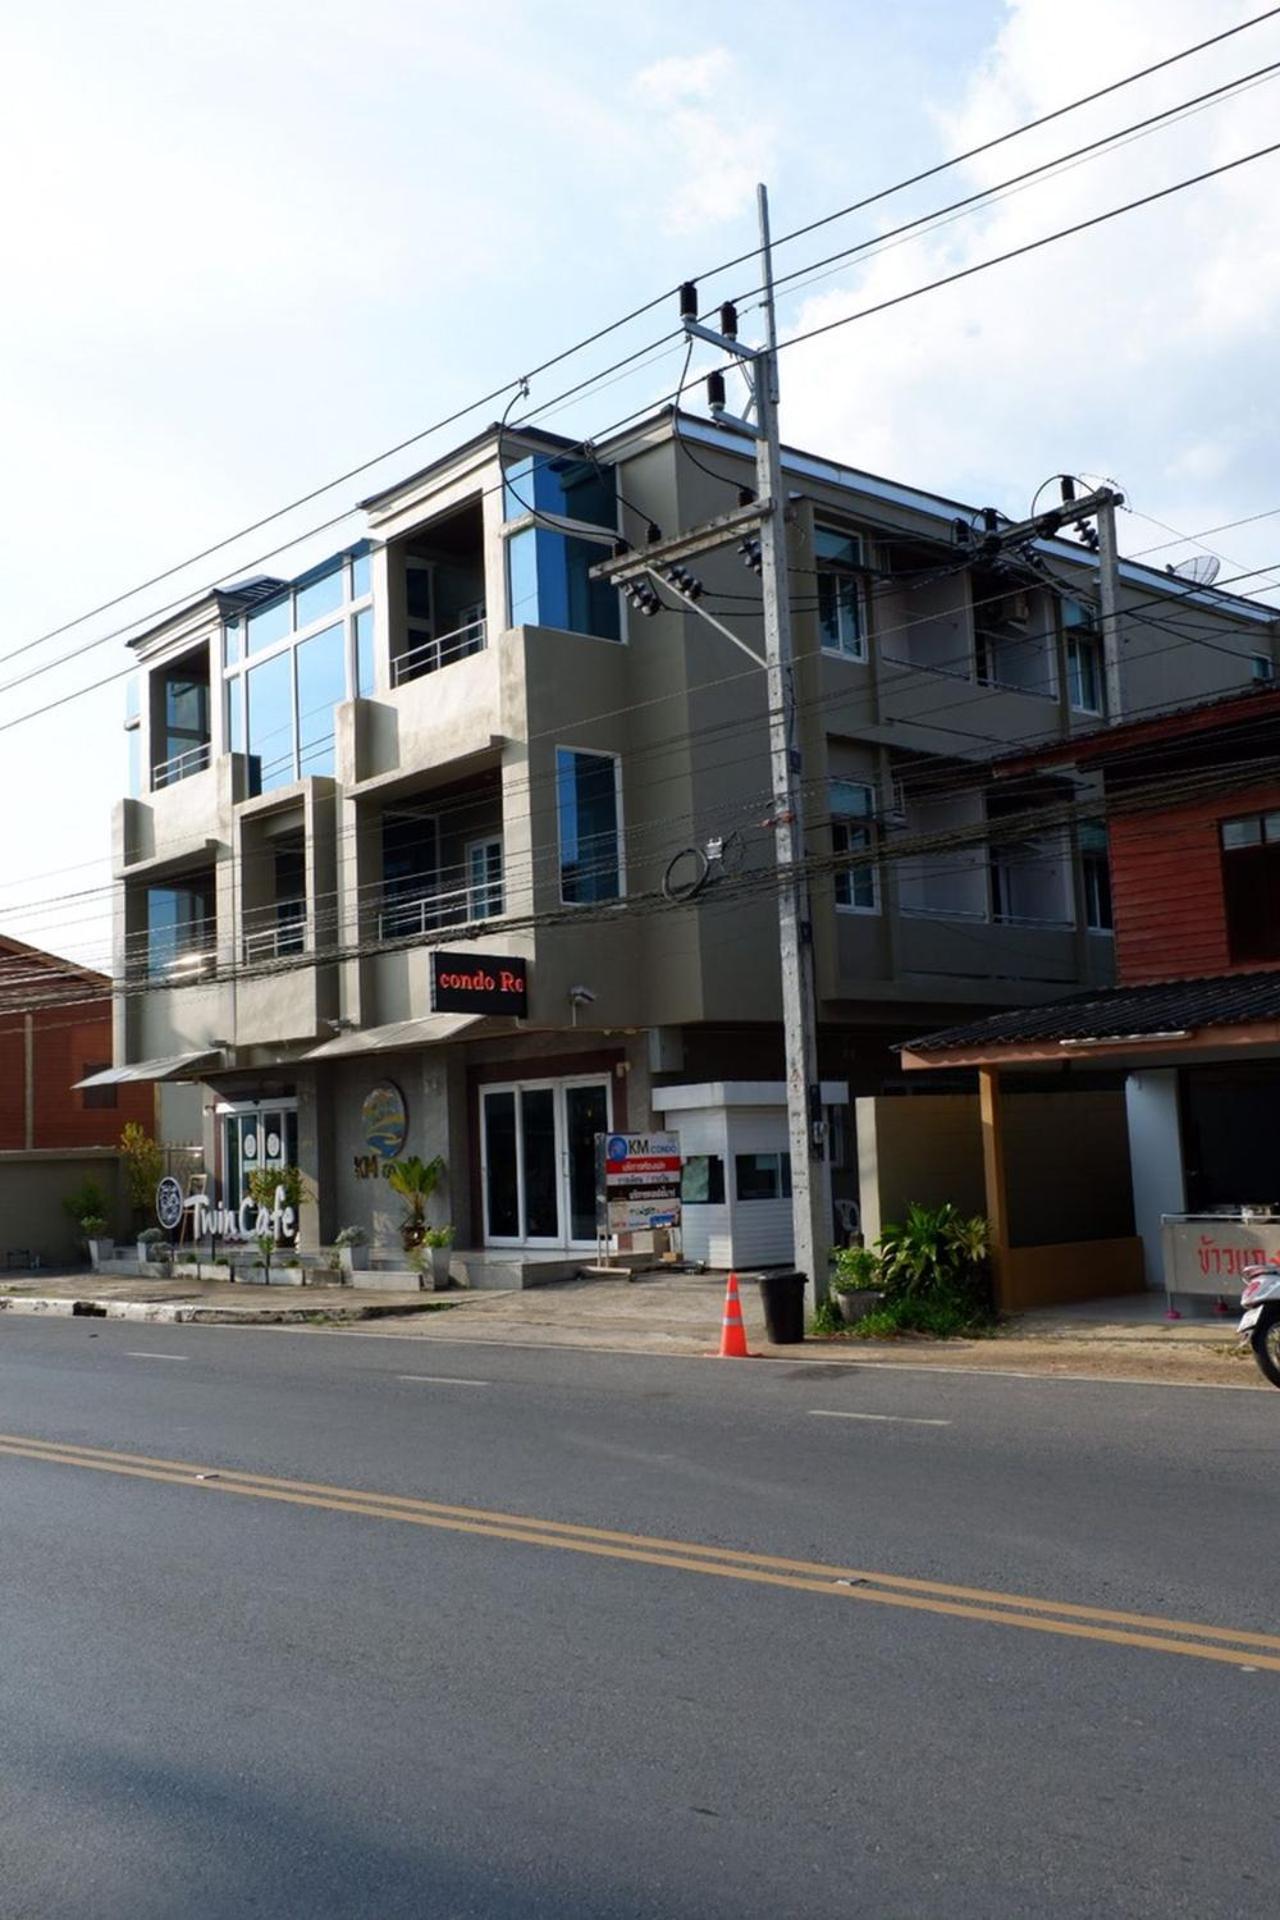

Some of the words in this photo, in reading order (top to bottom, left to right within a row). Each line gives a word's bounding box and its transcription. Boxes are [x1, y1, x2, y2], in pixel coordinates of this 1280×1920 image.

[439, 969, 495, 991] condo
[629, 1139, 649, 1155] KM
[651, 1144, 677, 1154] CONDO
[184, 1194, 238, 1240] Twin
[239, 1185, 295, 1241] Cafe
